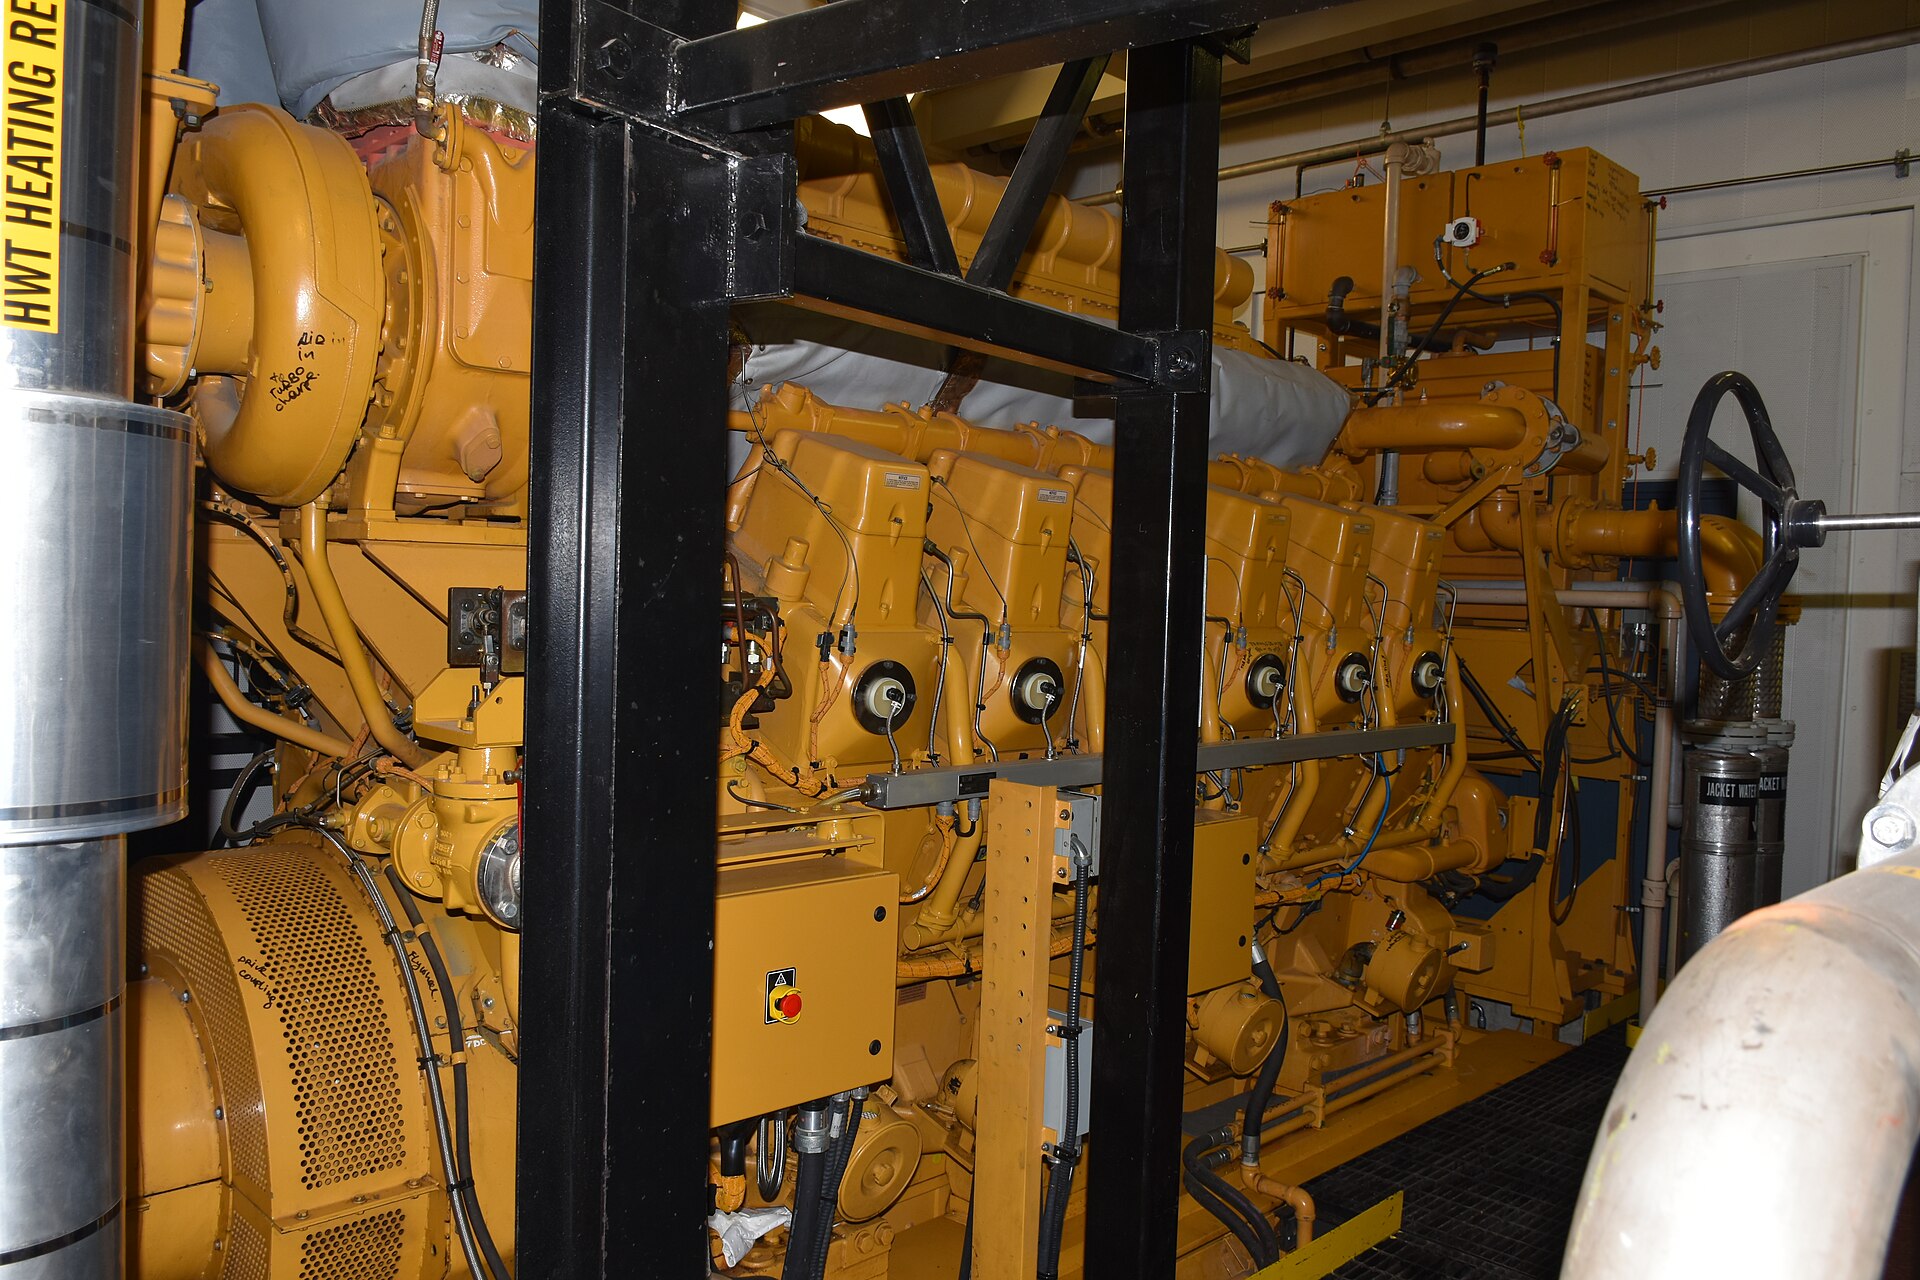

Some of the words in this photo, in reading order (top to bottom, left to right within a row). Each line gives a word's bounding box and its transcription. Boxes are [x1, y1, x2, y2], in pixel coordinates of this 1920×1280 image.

[6, 60, 57, 229] HEATING
[4, 238, 51, 326] HWT
[1706, 782, 1736, 798] JACKET
[1759, 777, 1780, 791] ACKET
